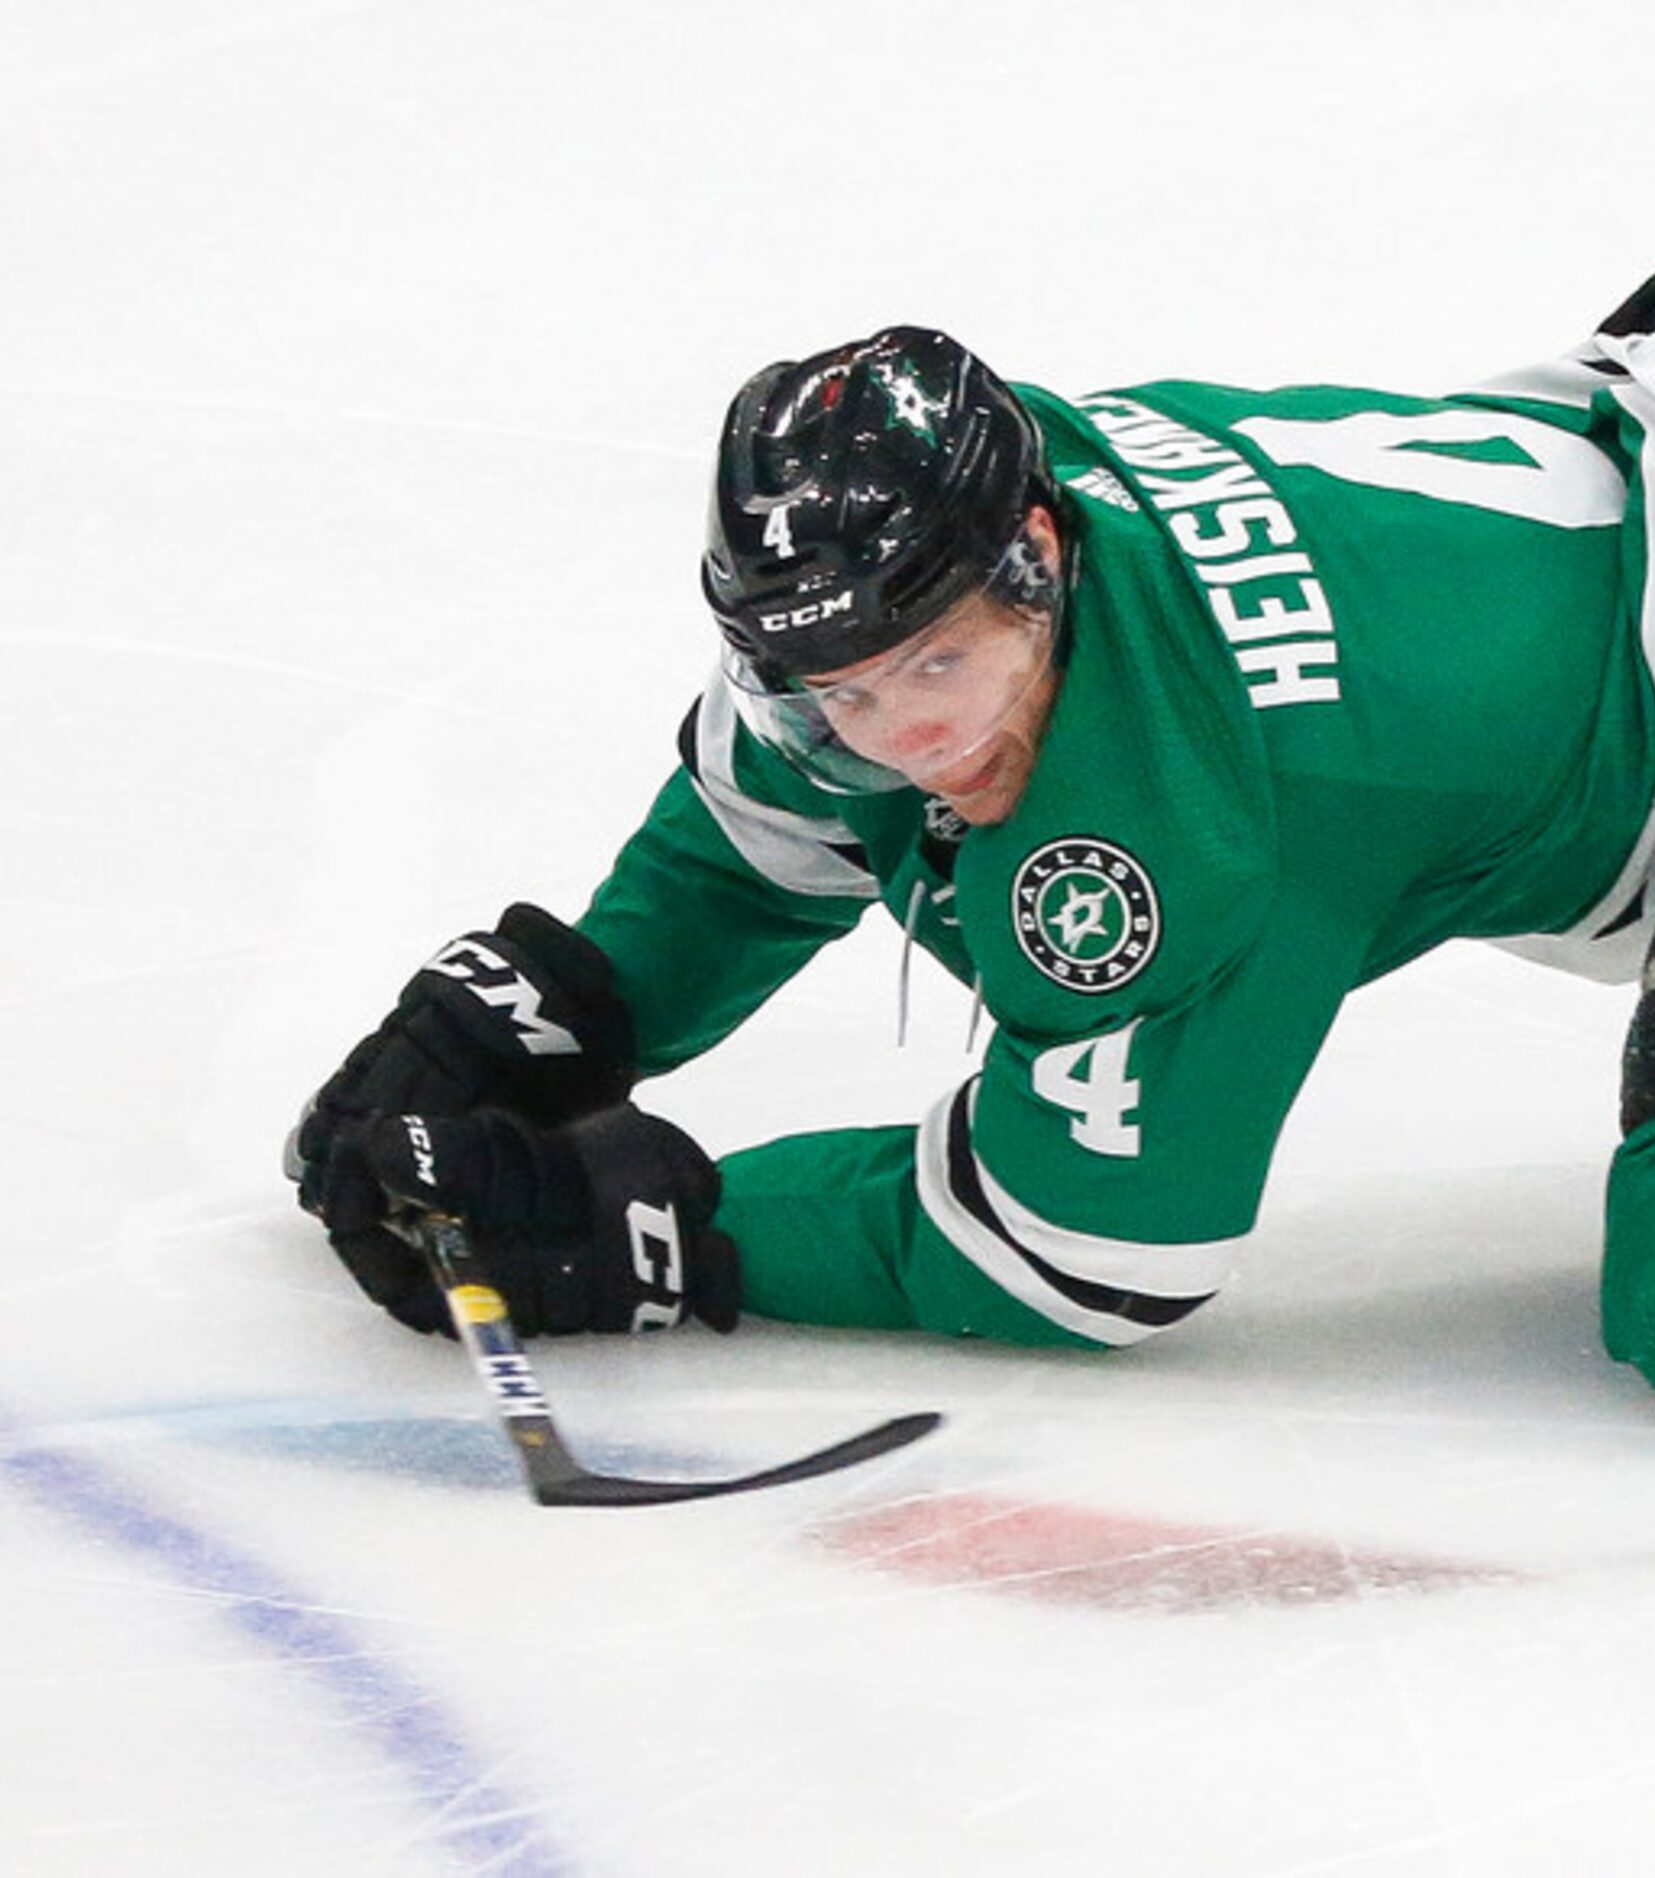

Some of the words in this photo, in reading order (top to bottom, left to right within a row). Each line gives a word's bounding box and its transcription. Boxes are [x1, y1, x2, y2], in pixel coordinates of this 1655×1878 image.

[1228, 409, 1628, 528] 4
[763, 503, 796, 559] 4
[759, 590, 854, 631] CCM
[1019, 850, 1131, 932] DALLAS
[1052, 914, 1150, 983] STARS
[1031, 1015, 1145, 1158] 4
